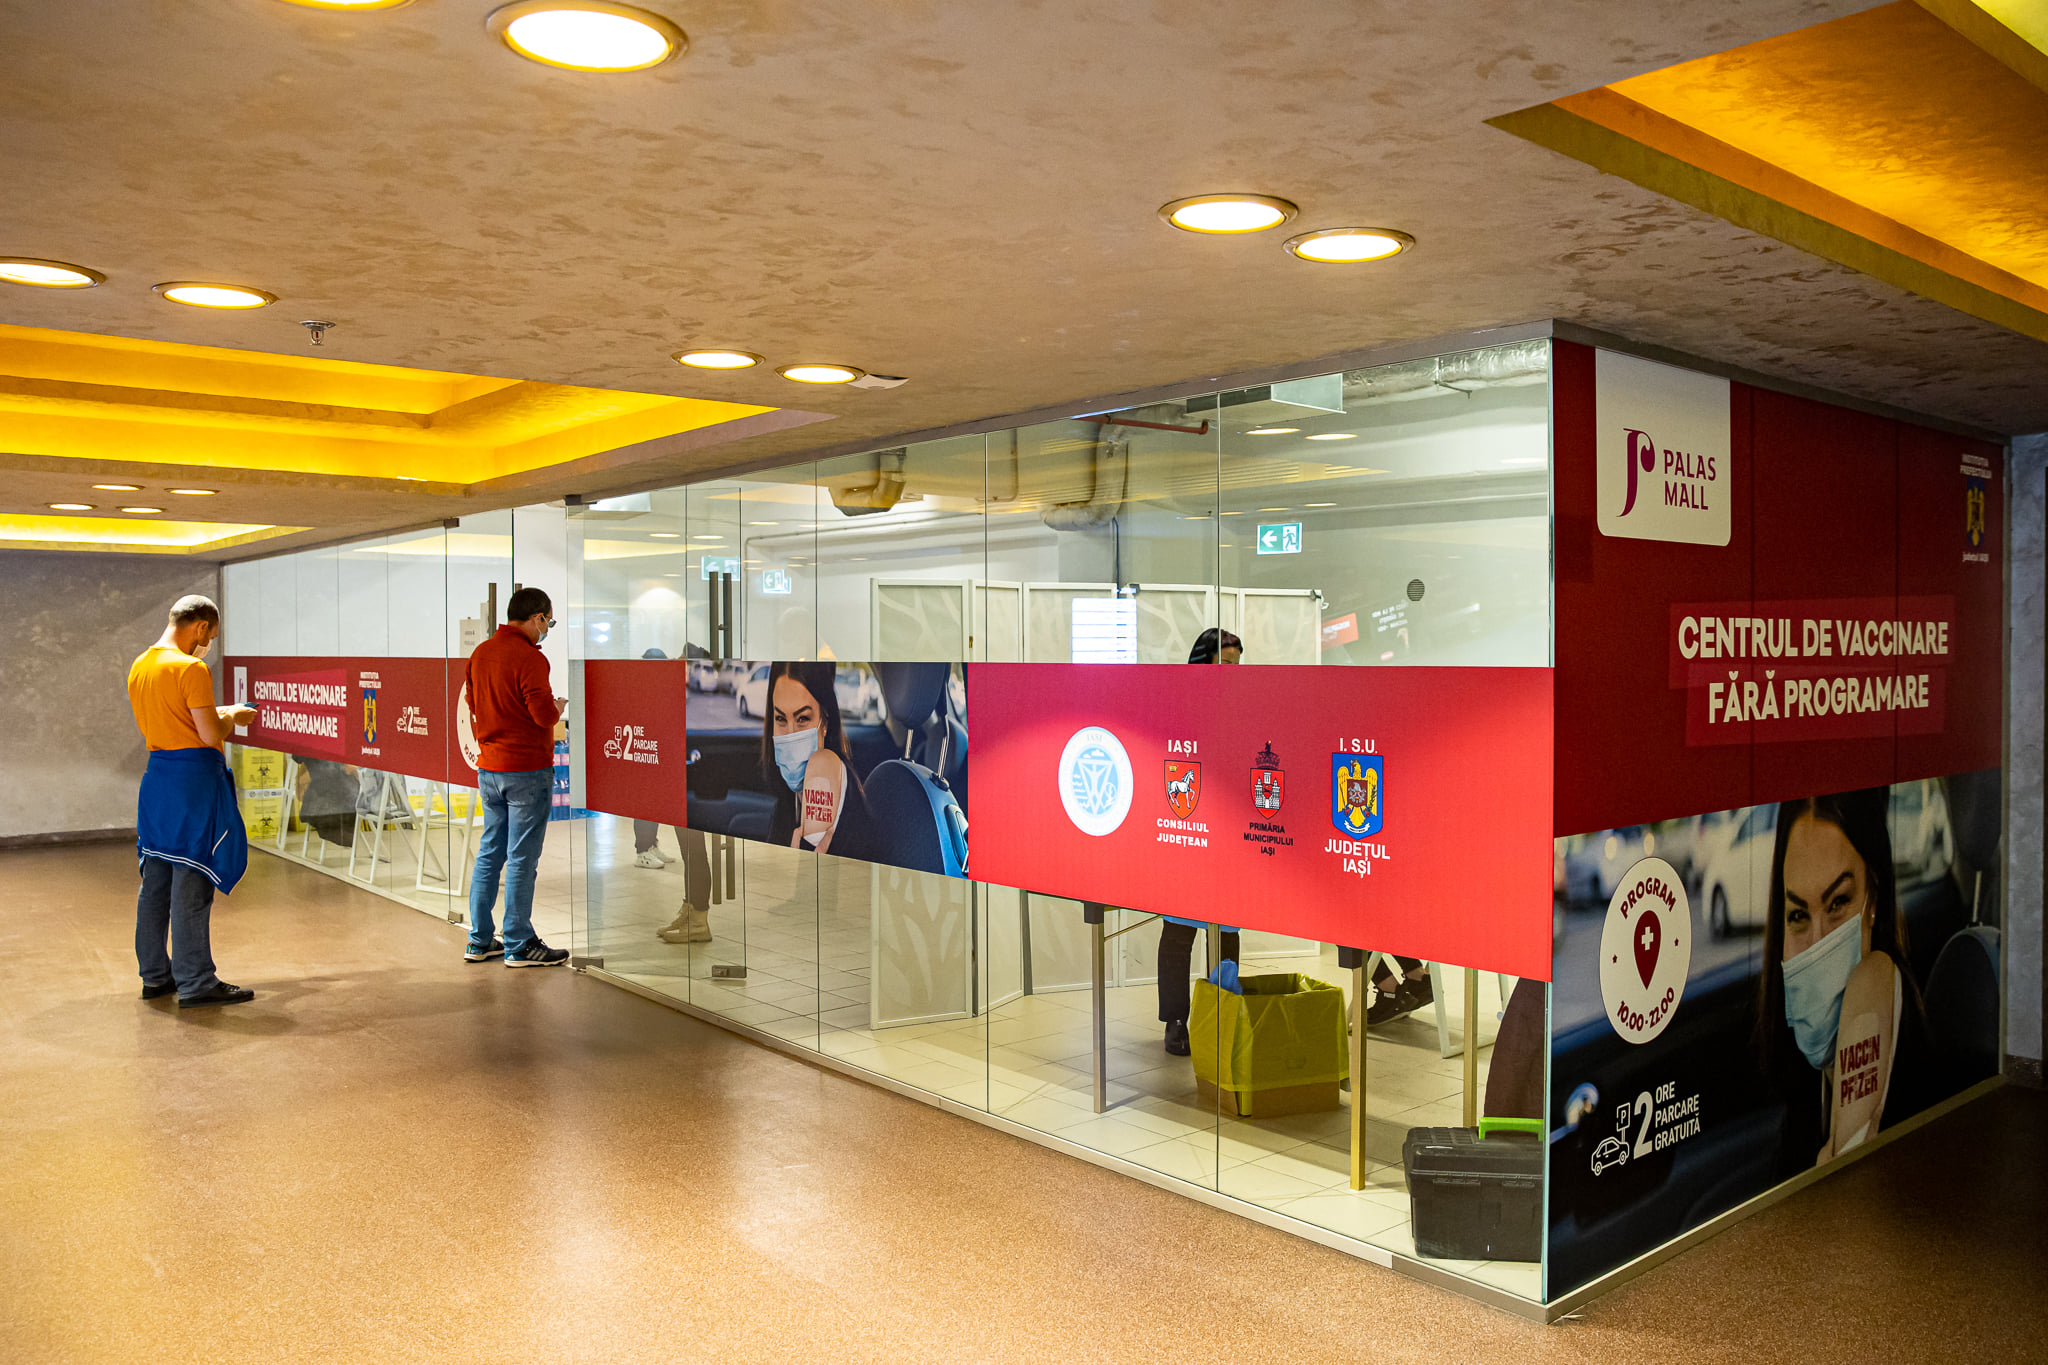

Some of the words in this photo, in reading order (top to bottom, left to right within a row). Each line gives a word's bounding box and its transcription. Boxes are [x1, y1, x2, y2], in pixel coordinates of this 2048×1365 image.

[1662, 448, 1716, 482] PALAS
[1663, 481, 1709, 511] MALL
[1678, 616, 1799, 660] CENTRUL
[1803, 619, 1833, 657] DE
[1835, 619, 1949, 658] VACCINARE
[254, 680, 286, 702] CENTRUL
[287, 682, 298, 702] DE
[298, 683, 347, 707] VACCINARE
[1708, 669, 1780, 724] FĂRĂ
[1783, 673, 1930, 719] PROGRAMARE
[261, 705, 281, 730] FĂRĂ
[281, 711, 338, 738] PROGRAMARE
[407, 705, 414, 734] 2
[633, 725, 645, 737] ORE
[623, 724, 634, 761] 2
[633, 738, 658, 752] PARCARE
[1167, 739, 1198, 758] IAȘI
[633, 752, 659, 765] GRATUITĂ
[804, 788, 833, 807] VACCIN
[805, 804, 833, 824] PFIZER
[1156, 818, 1209, 833] CONSILIUL
[1156, 832, 1208, 848] JUDEȚEAN
[1243, 833, 1294, 846] MUNICIPIULUI
[1249, 822, 1285, 834] PRIMĂRIA
[1260, 846, 1275, 857] IAȘI
[1324, 838, 1391, 861] JUDEȚUL
[1343, 857, 1371, 879] IAȘI
[1620, 877, 1677, 920] PROGRAM
[1840, 1034, 1880, 1075] VACCIN
[1655, 1080, 1676, 1104] ORE
[1840, 1066, 1878, 1108] PFIZER
[1655, 1094, 1700, 1128] PARCARE
[1633, 1090, 1653, 1160] 2
[1655, 1112, 1701, 1151] GRATUITĂ
